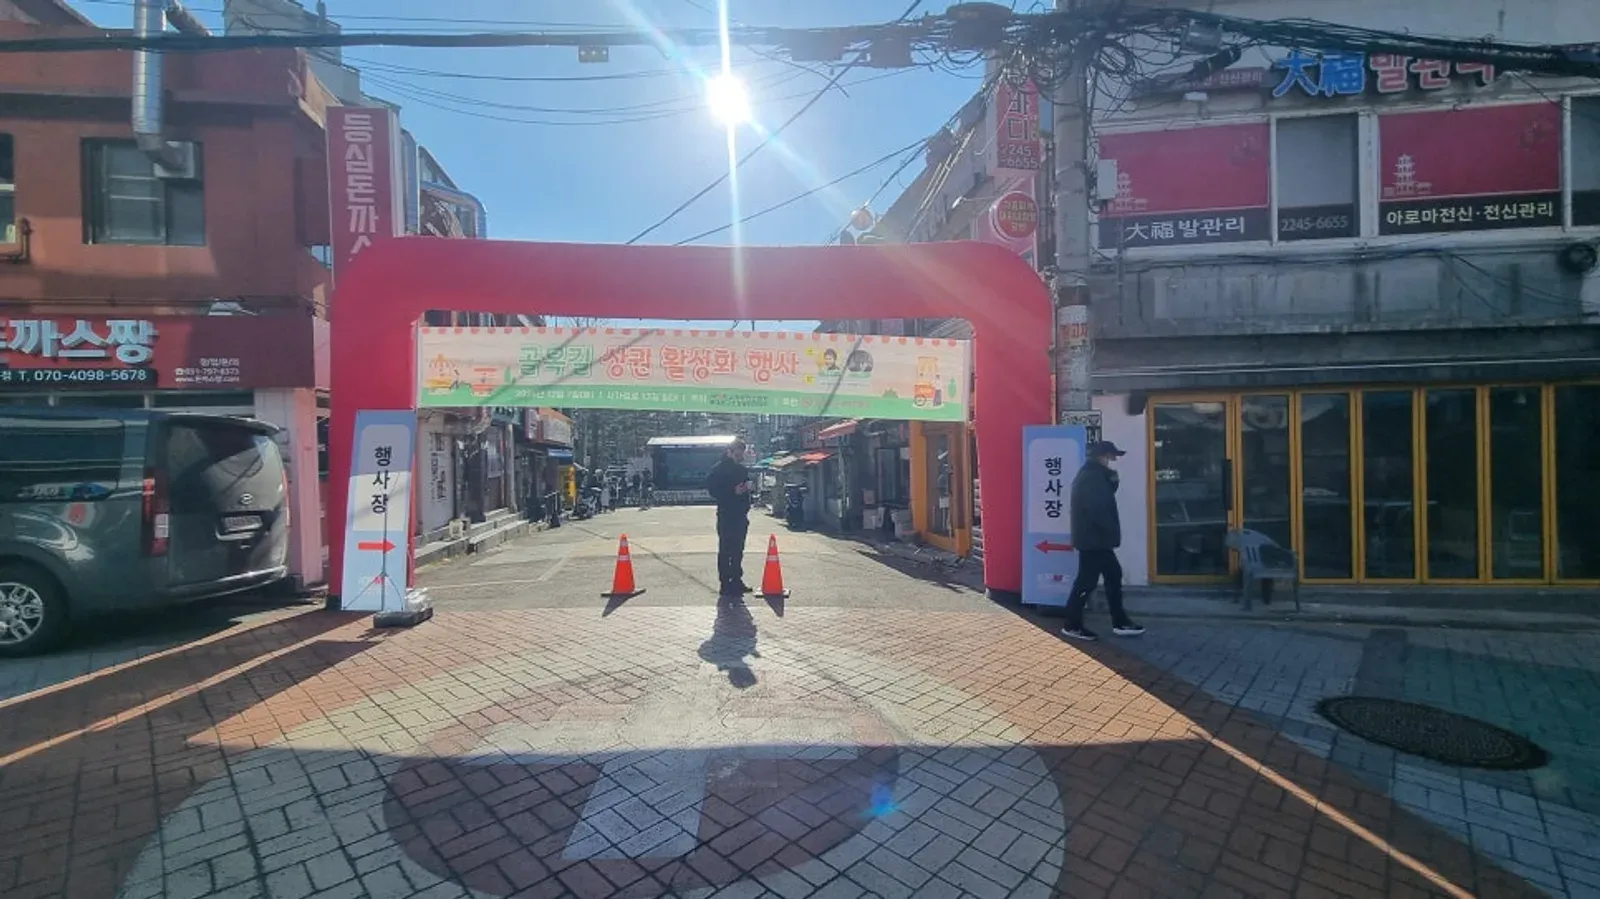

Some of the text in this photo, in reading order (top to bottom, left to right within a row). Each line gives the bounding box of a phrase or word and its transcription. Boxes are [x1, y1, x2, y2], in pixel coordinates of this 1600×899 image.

[1125, 216, 1246, 241] 大福 발관리
[1281, 215, 1349, 232] 2245-6655
[34, 369, 147, 381] 070-4098-5678
[518, 345, 799, 384] 골목길 상권 활성화 행사
[371, 446, 392, 514] 행사장
[1044, 457, 1064, 518] 행사장
